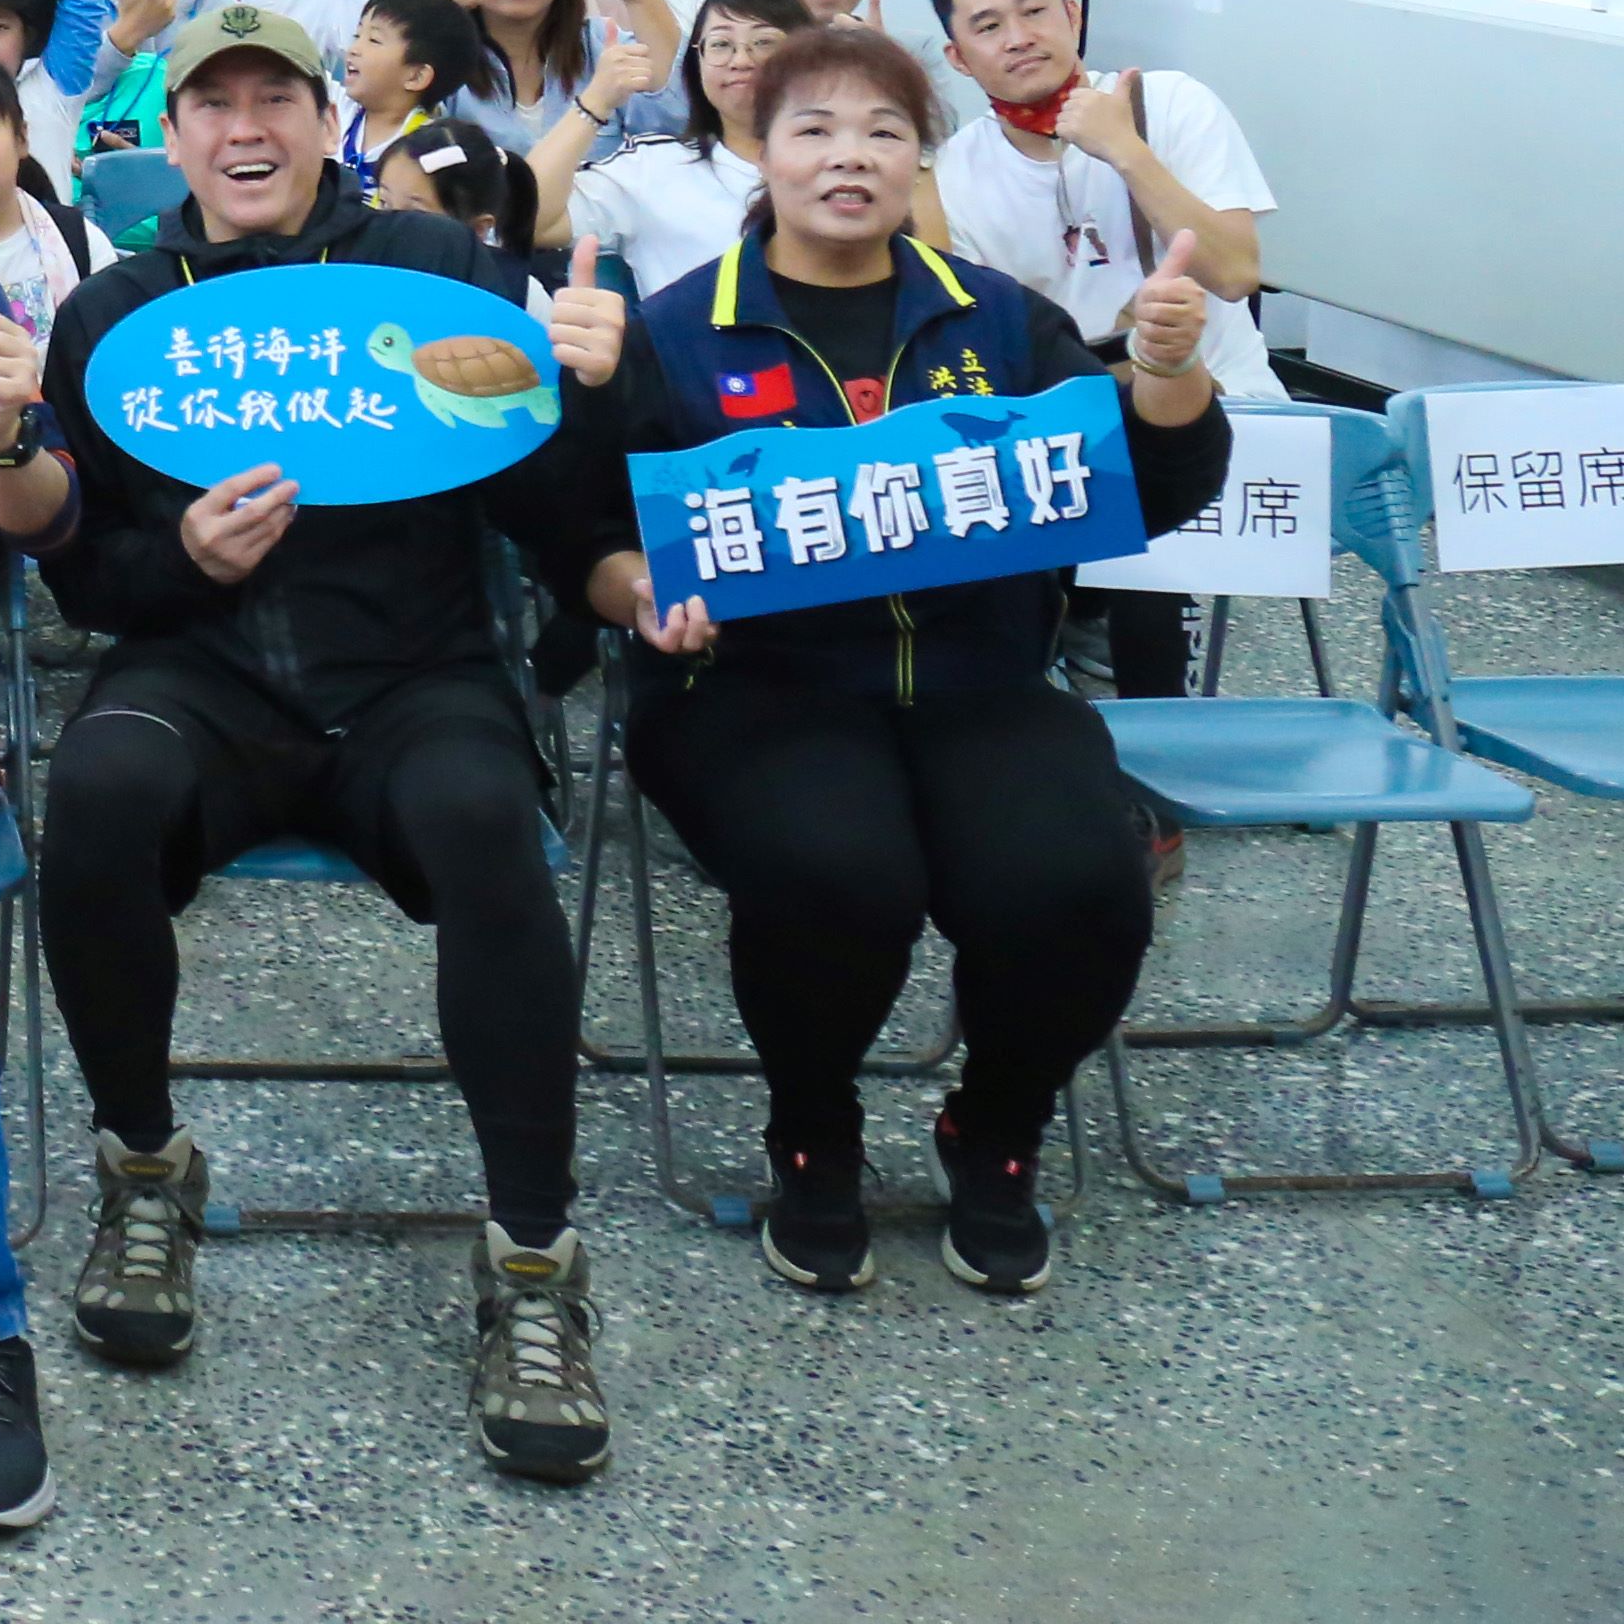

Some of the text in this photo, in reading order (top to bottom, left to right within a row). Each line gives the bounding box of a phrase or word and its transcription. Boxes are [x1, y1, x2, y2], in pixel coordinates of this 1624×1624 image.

[163, 326, 349, 380] 善待海洋
[121, 388, 398, 433] 從你我做起
[683, 432, 1092, 583] 海有你真好
